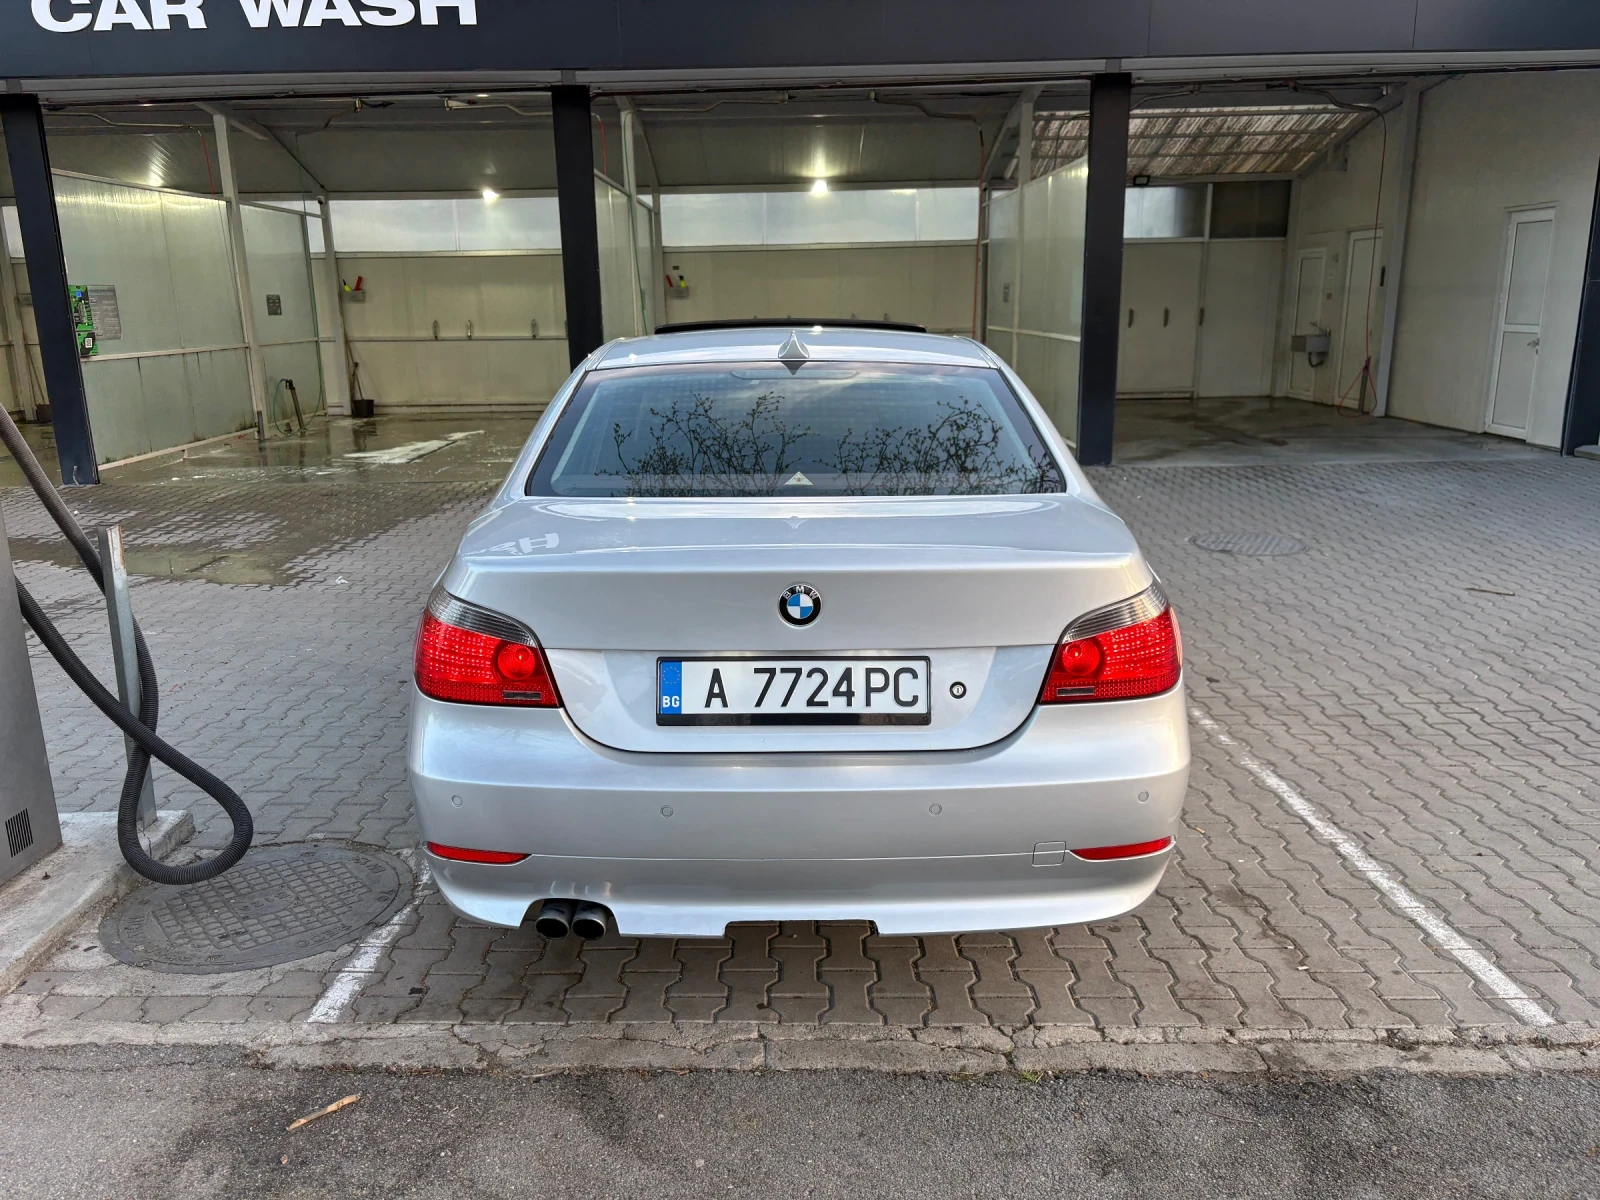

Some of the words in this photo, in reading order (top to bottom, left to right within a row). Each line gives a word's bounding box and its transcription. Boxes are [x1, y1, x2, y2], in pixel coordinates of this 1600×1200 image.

[31, 0, 208, 33] CAR
[239, 0, 478, 28] WASH
[782, 585, 819, 600] BMW
[704, 668, 729, 709] A
[662, 695, 680, 708] BG
